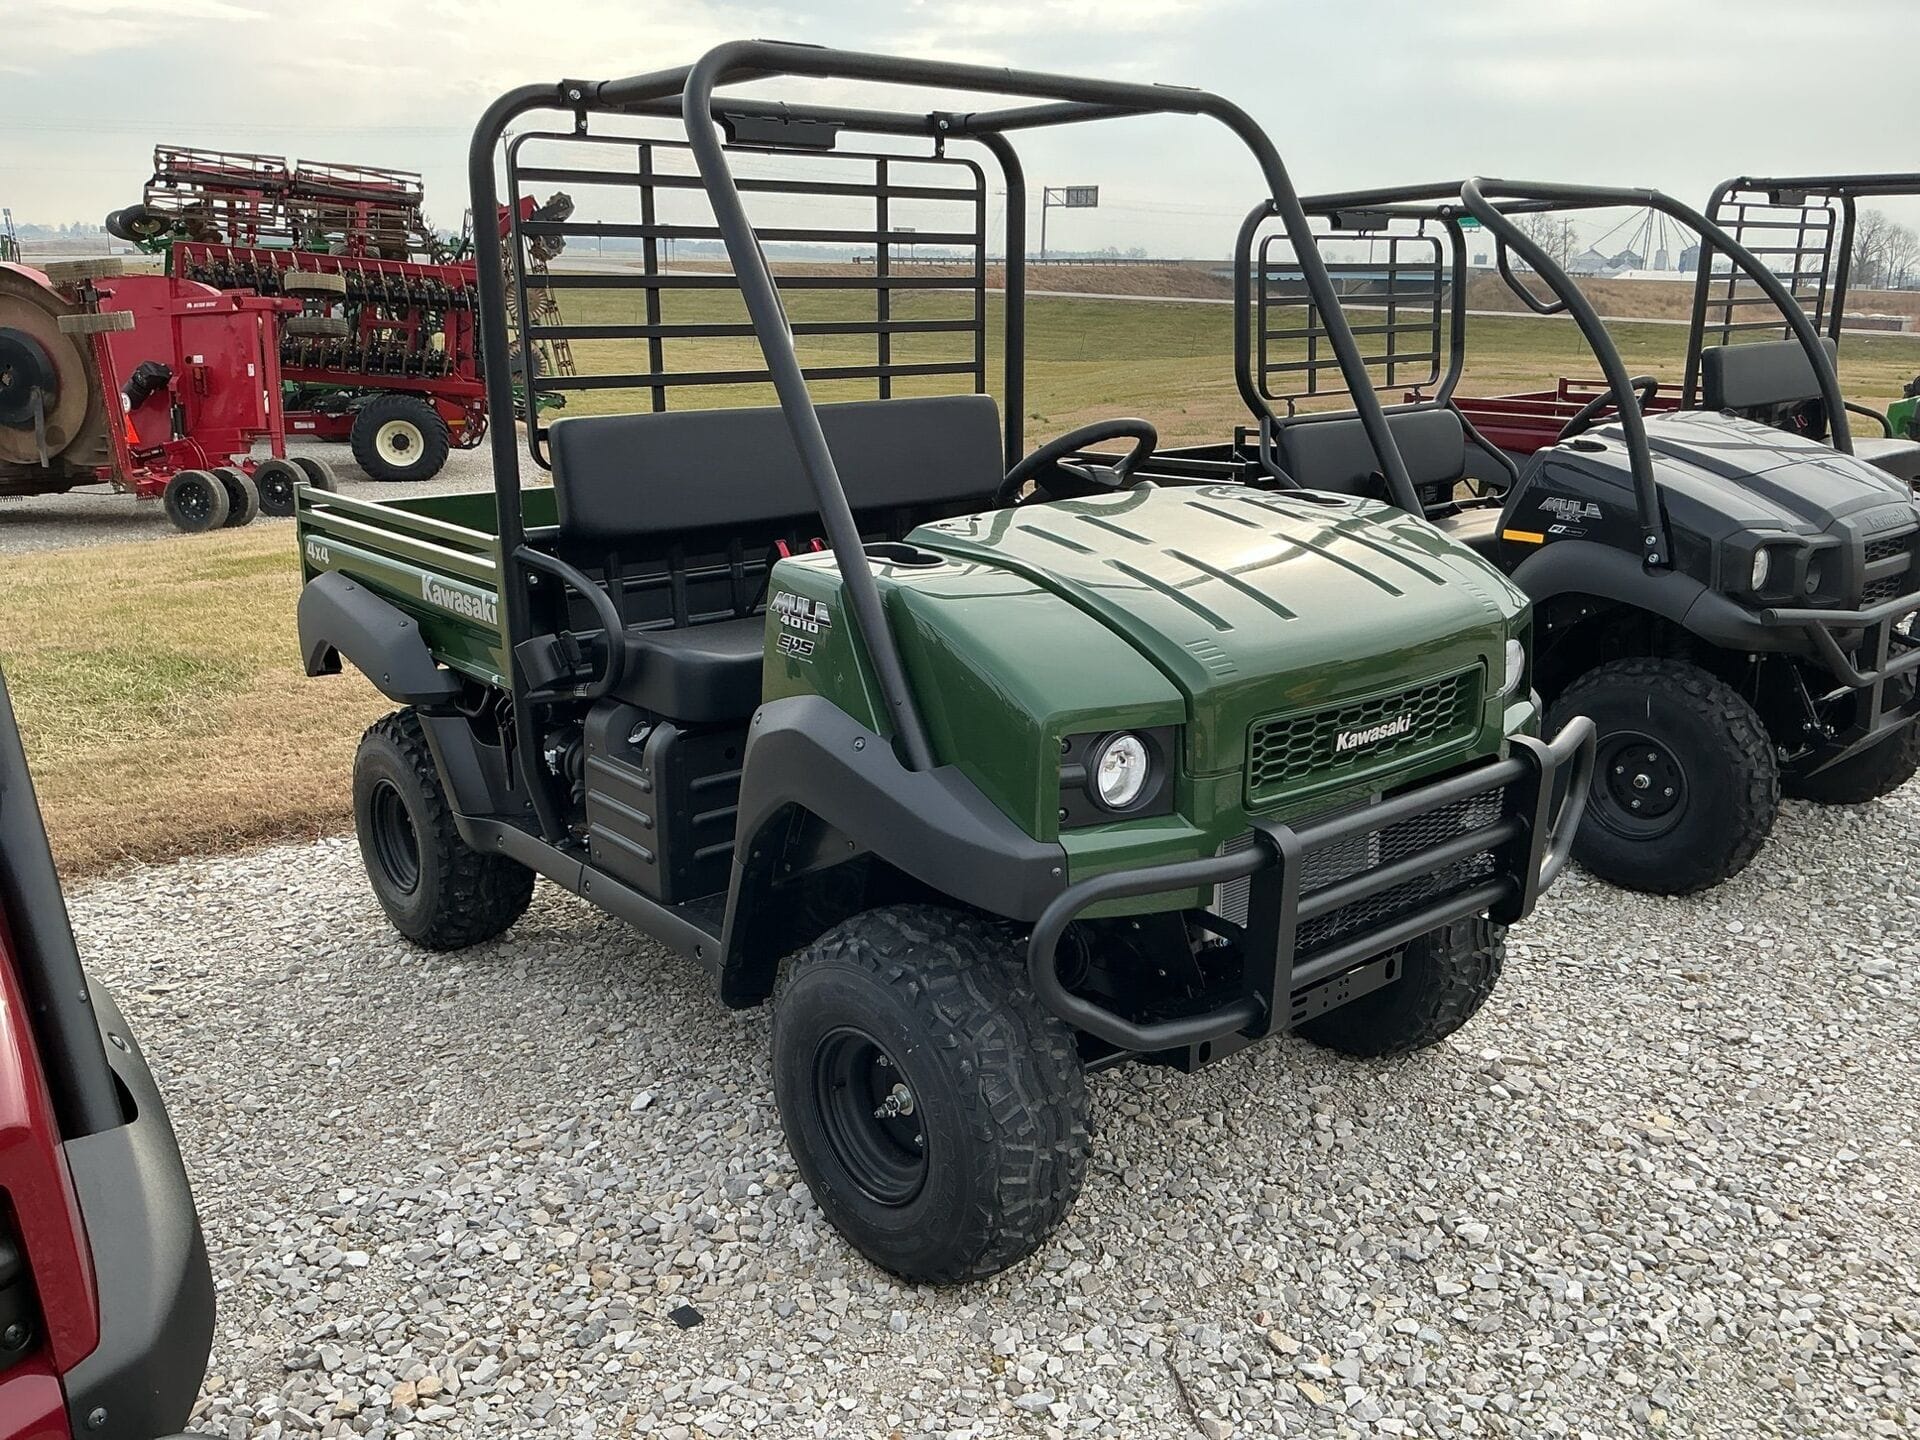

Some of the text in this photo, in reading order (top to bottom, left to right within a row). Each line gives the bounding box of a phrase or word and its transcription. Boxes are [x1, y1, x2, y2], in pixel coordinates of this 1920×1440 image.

[1538, 496, 1602, 519] MULE
[307, 541, 330, 564] 4x4
[421, 574, 498, 625] Kawasaki
[769, 590, 832, 629] MULE
[780, 615, 819, 634] 4010
[777, 632, 815, 656] EPS
[1336, 713, 1411, 752] Kawasaki
